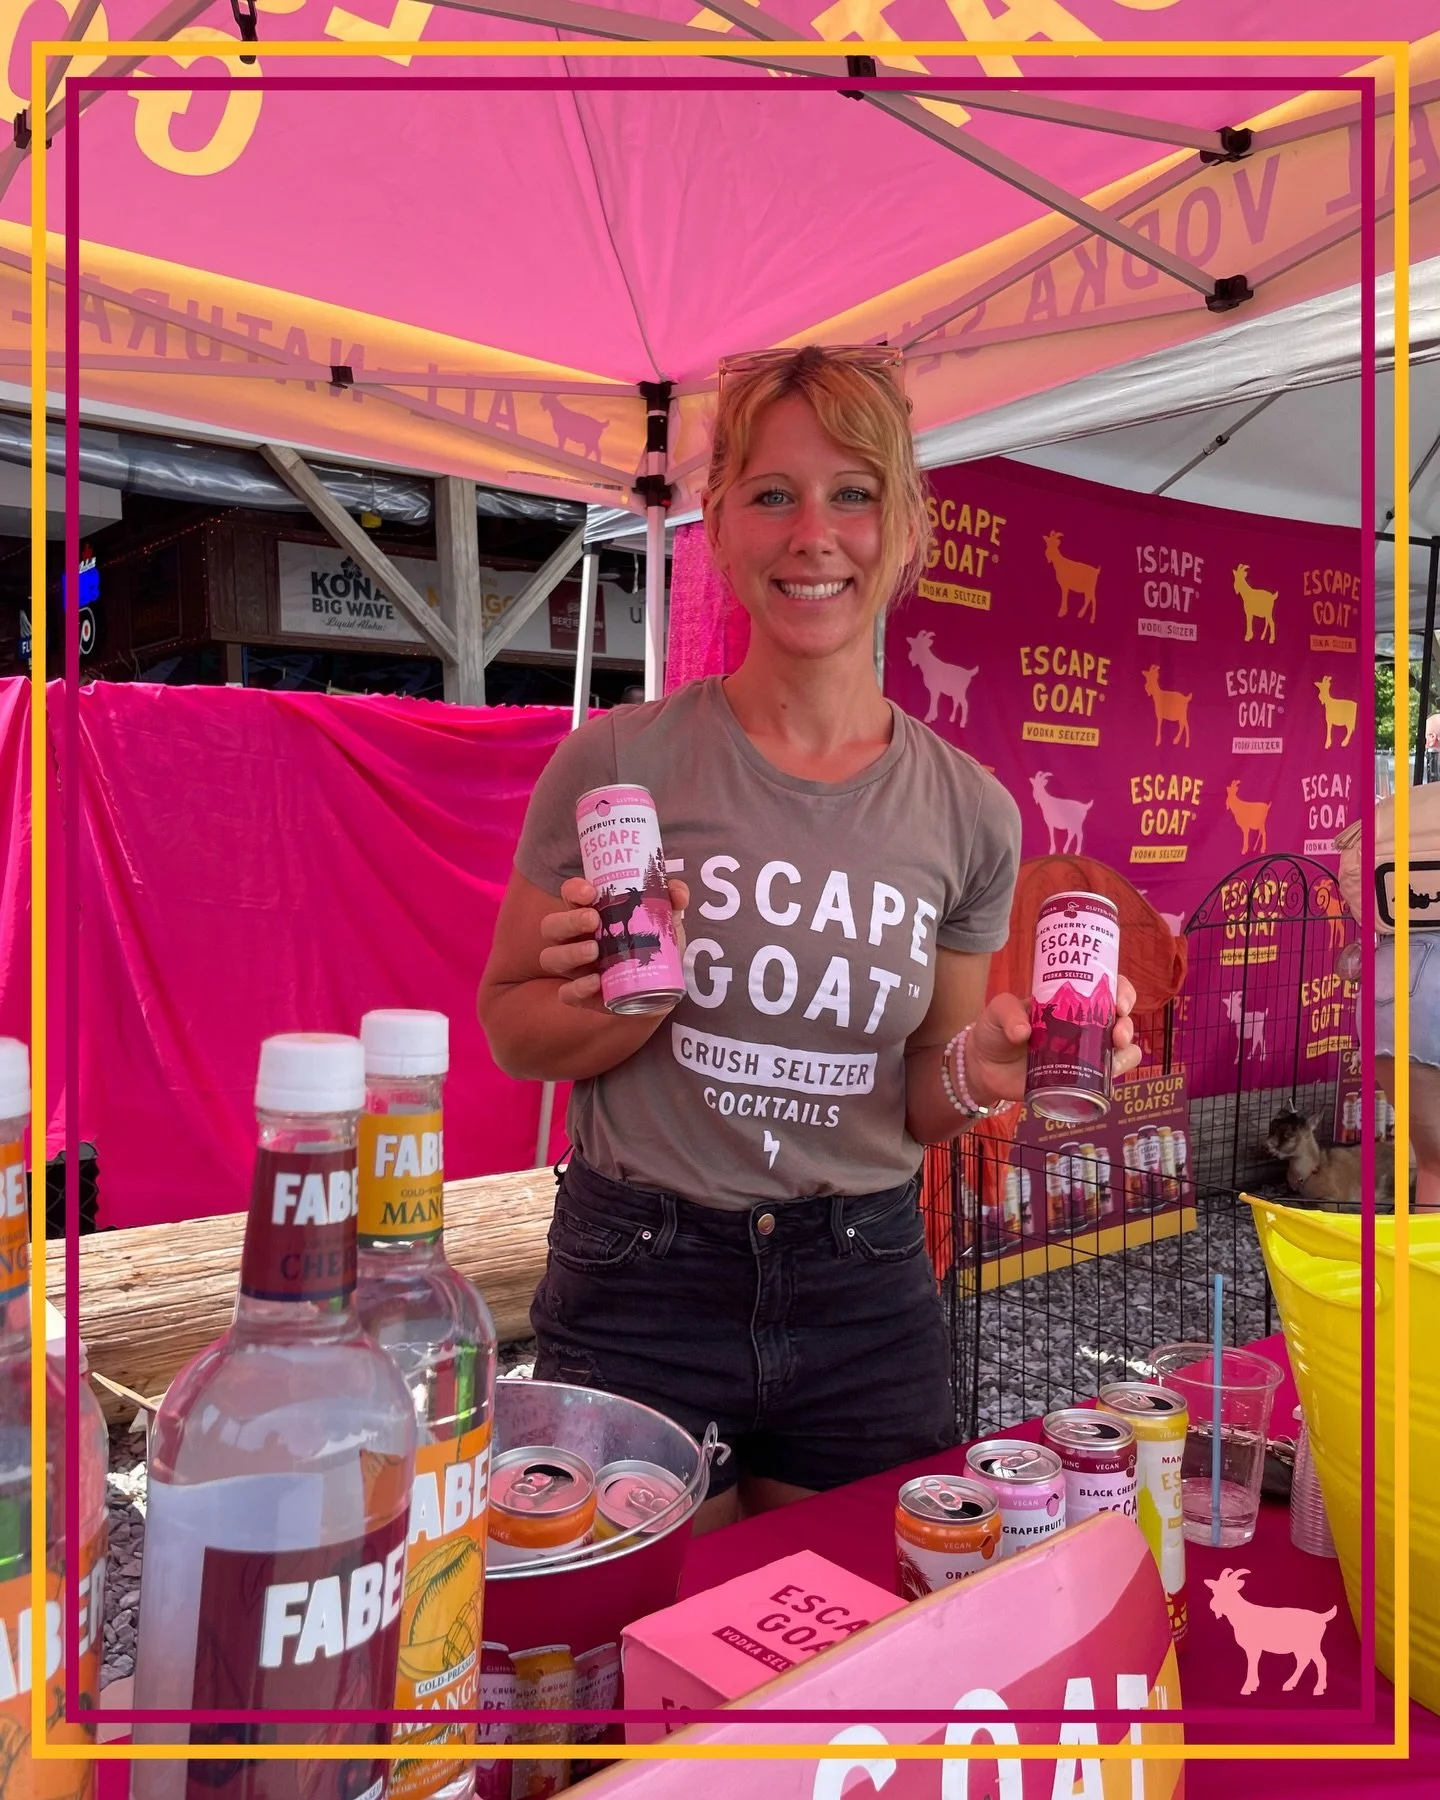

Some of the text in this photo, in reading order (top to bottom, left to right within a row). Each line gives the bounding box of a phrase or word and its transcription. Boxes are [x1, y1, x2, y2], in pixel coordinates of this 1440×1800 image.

[924, 537, 989, 578] GOAT
[954, 588, 987, 606] SELTZER
[1143, 580, 1196, 613] GOAT
[1303, 568, 1361, 602] ESCAPE
[312, 597, 394, 620] BIG WAVE
[1312, 600, 1352, 628] GOAT
[1020, 645, 1111, 686] ESCAPE
[1226, 668, 1286, 700] ESCAPE
[1033, 682, 1098, 717] GOAT
[1238, 701, 1276, 729] GOAT
[1027, 726, 1096, 742] VODKA SELTZER
[1130, 773, 1204, 806] ESCAPE
[619, 816, 647, 824] CRUSH
[1141, 808, 1191, 836] GOAT
[583, 829, 641, 858] ESCAPE
[1133, 849, 1186, 859] VODKA SELTZER
[592, 847, 633, 871] GOAT
[665, 854, 937, 967] SCAPE
[1041, 932, 1102, 954] ESCAPE
[1053, 922, 1087, 930] CHERRY
[1090, 925, 1114, 939] CRUSH
[1047, 951, 1092, 967] GOAT
[682, 937, 902, 1035] GOAT
[1044, 971, 1092, 980] VODKA SELTZER
[680, 1036, 870, 1087] CRUSH SELTZER
[1114, 1077, 1184, 1102] GET YOUR
[1124, 1092, 1175, 1115] GOATS!
[703, 1086, 841, 1129] COCKTAILS
[1012, 1499, 1039, 1507] VEGAN
[1079, 1488, 1113, 1497] BLACK
[1003, 1520, 1062, 1535] GRAPEFRUIT
[720, 1628, 760, 1657] VODKA
[417, 1654, 475, 1696] COLD-PRESSED
